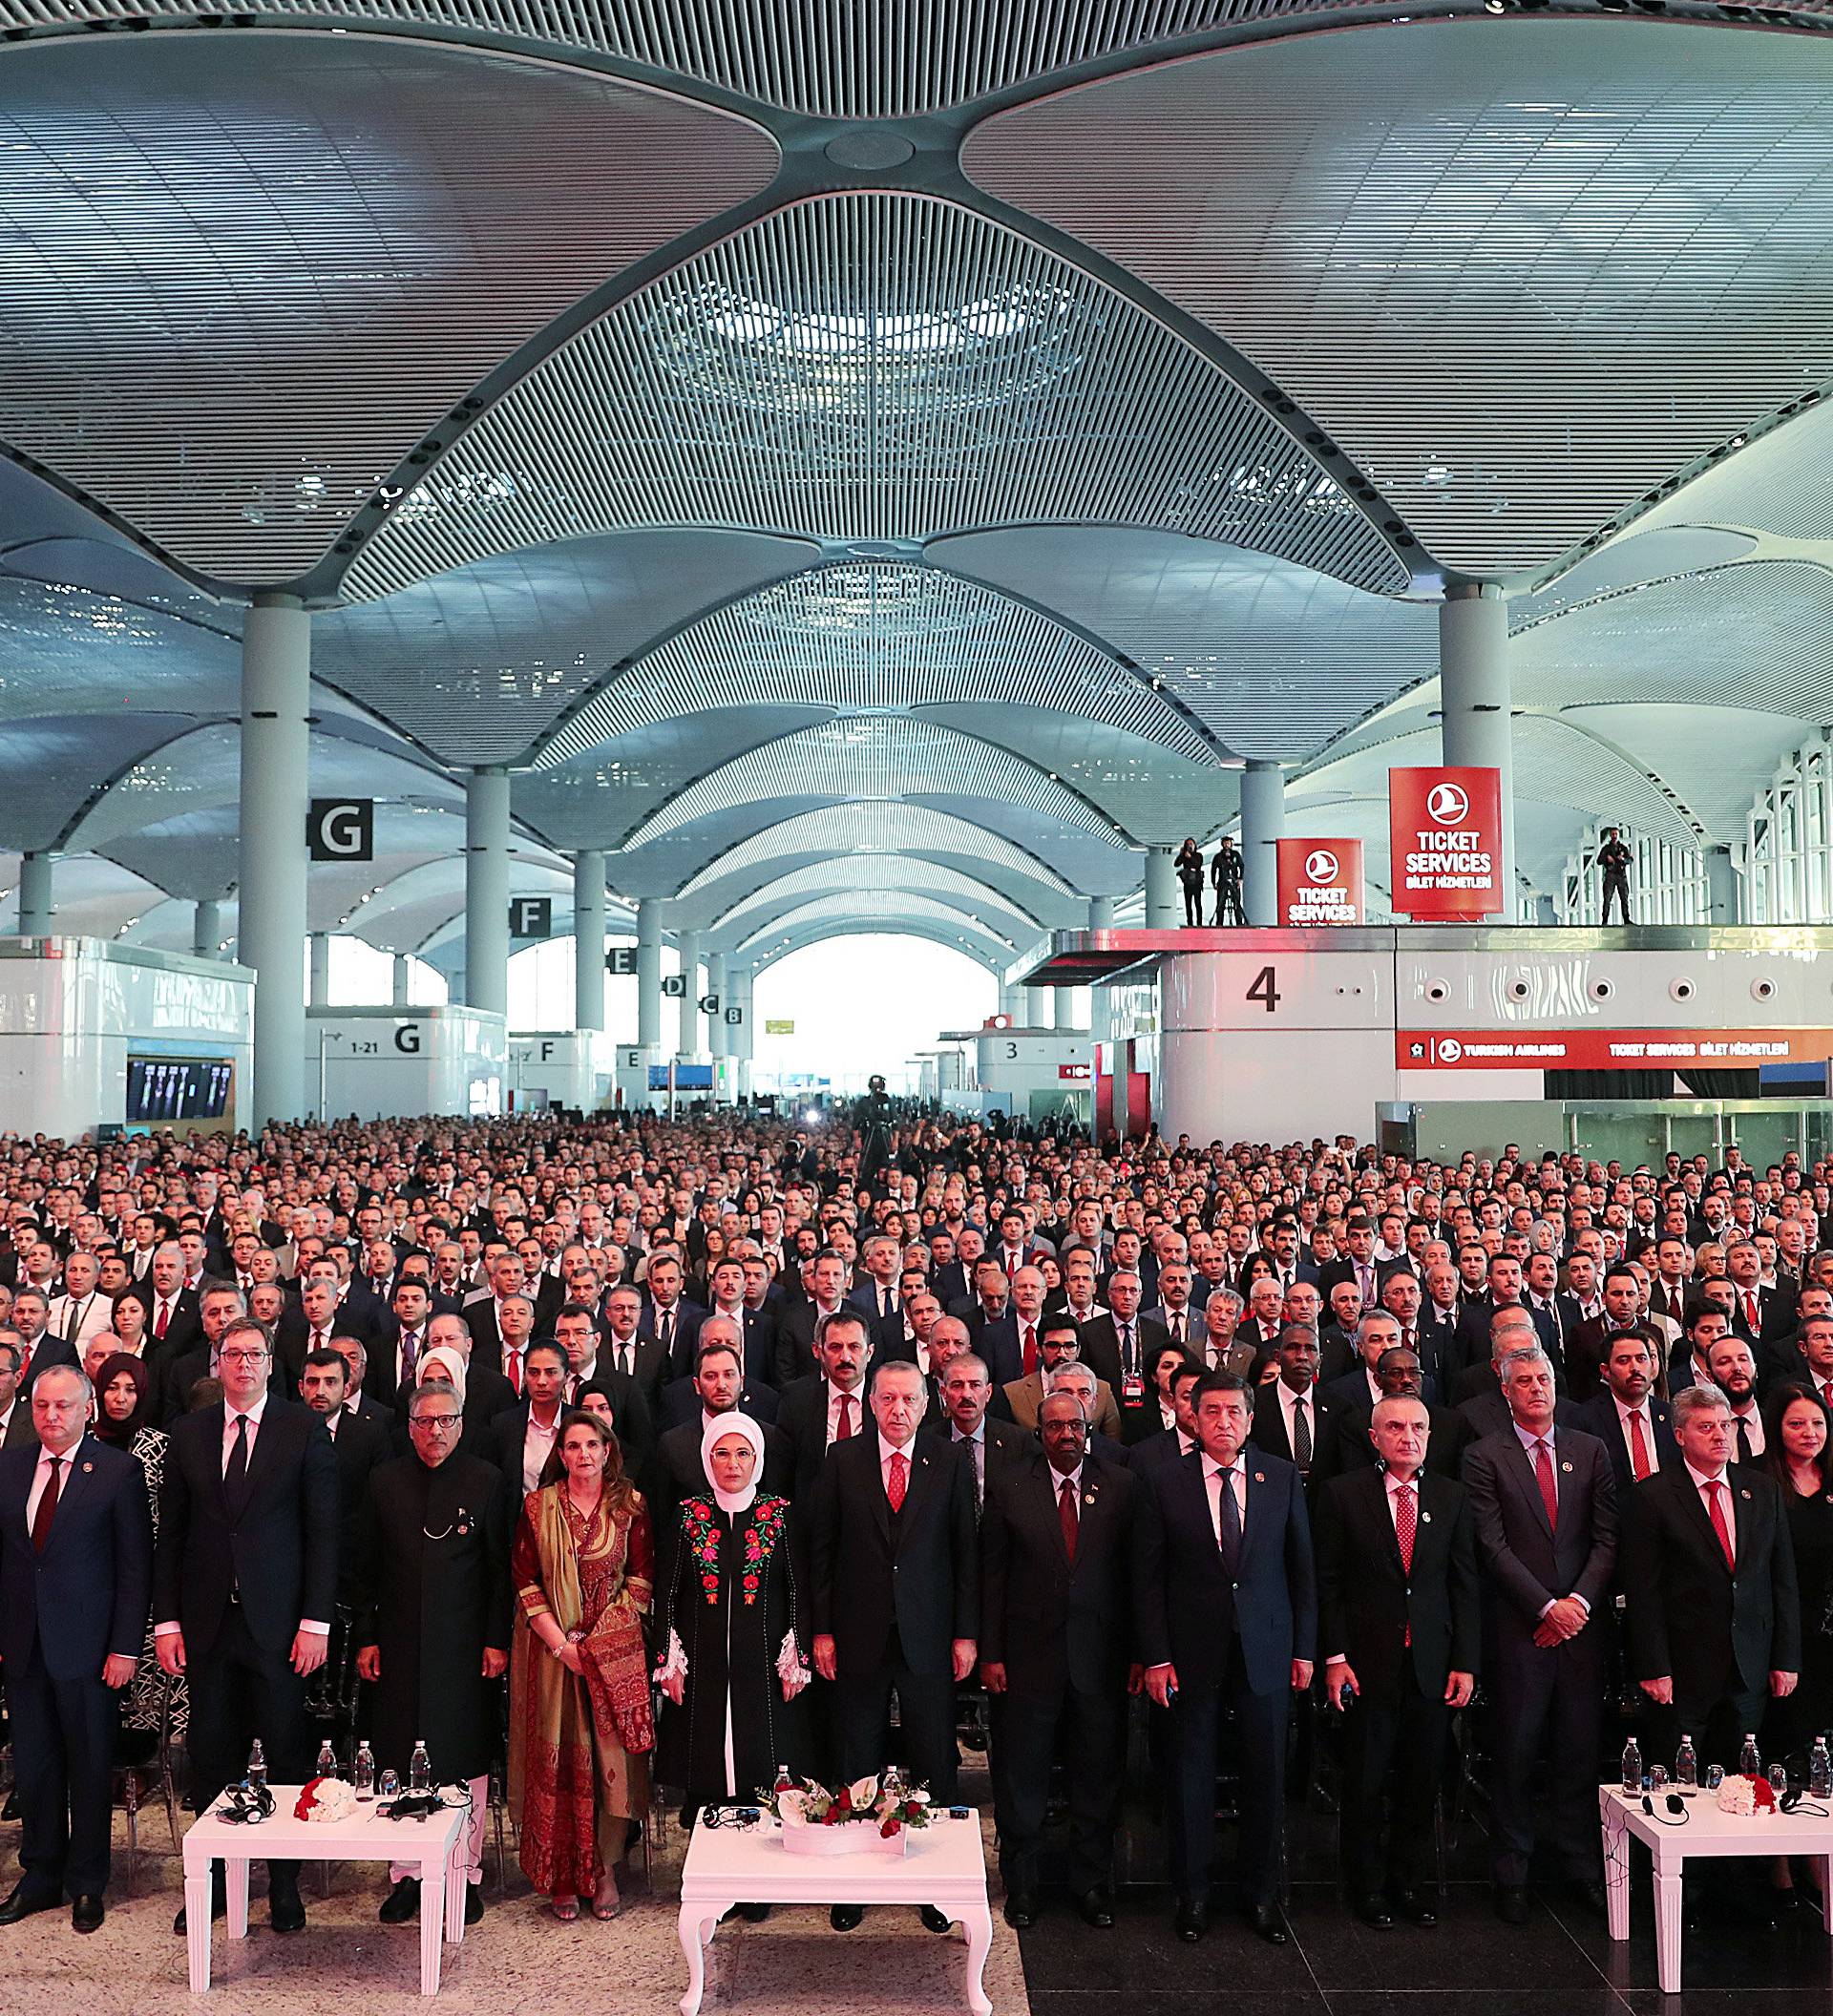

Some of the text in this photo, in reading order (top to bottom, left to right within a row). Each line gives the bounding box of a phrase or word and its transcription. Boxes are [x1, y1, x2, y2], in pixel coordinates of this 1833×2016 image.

[321, 806, 362, 853] G
[1417, 831, 1481, 850] TICKET
[1405, 852, 1491, 872] SERVICES
[1296, 887, 1347, 904] TICKET
[521, 902, 540, 934] F
[1289, 904, 1356, 921] SERVICES
[615, 950, 630, 972] E
[667, 976, 684, 995] D
[1246, 967, 1281, 1012] 4
[703, 997, 717, 1013] C
[728, 1009, 740, 1022] B
[351, 1041, 378, 1053] 1-21
[394, 1024, 420, 1053] G
[541, 1041, 554, 1060] F
[628, 1052, 639, 1067] E
[1006, 1042, 1018, 1060] 3
